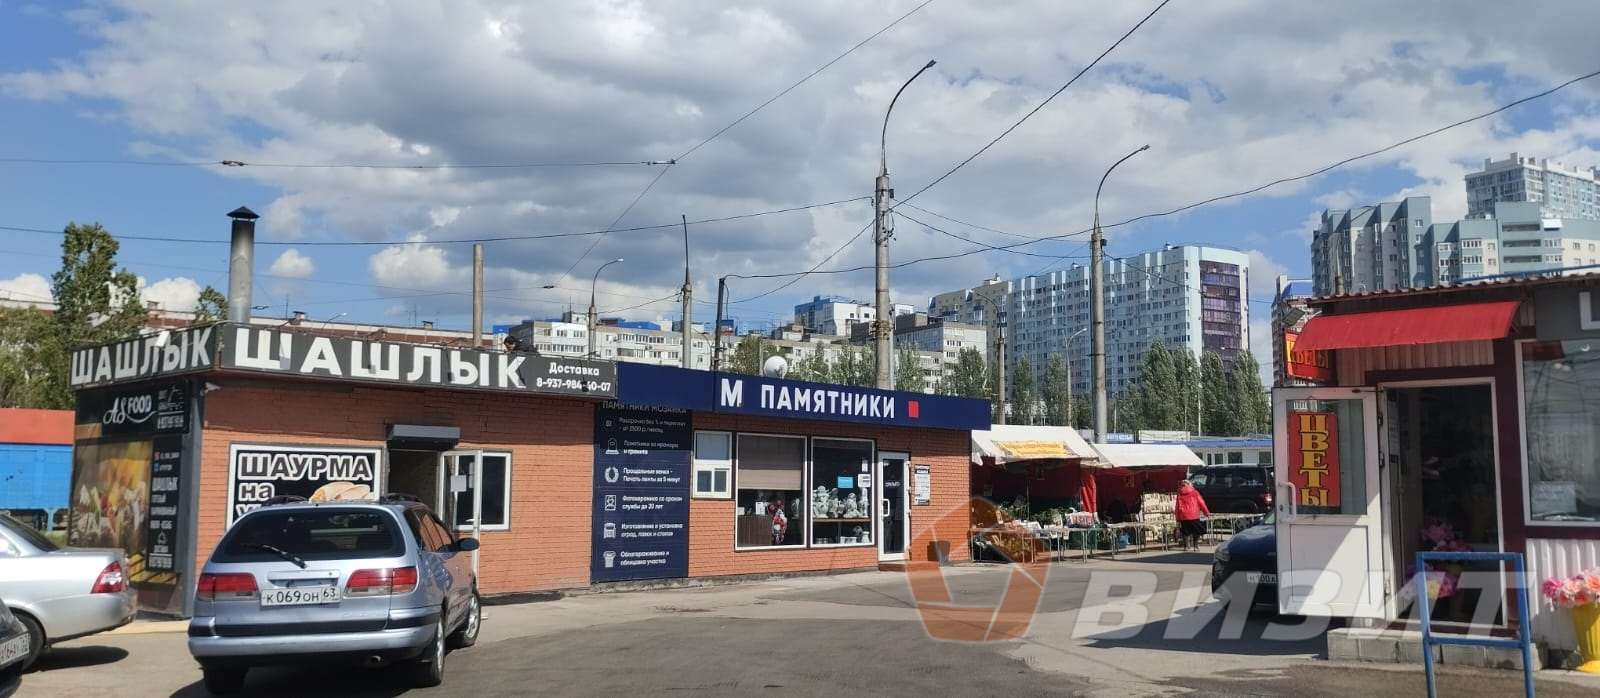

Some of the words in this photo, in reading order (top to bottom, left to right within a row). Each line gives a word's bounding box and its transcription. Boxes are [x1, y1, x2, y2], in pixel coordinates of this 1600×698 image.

[71, 327, 212, 386] ШАШЛЫК
[234, 327, 527, 389] ШАШЛЫК
[549, 362, 600, 377] Доставка
[127, 395, 152, 416] FOOD
[720, 378, 743, 408] М
[760, 383, 896, 419] ПАМЯТНИКИ
[237, 452, 373, 481] ШАУРМА
[1299, 413, 1329, 507] ЦВЕТЫ
[238, 482, 275, 502] на
